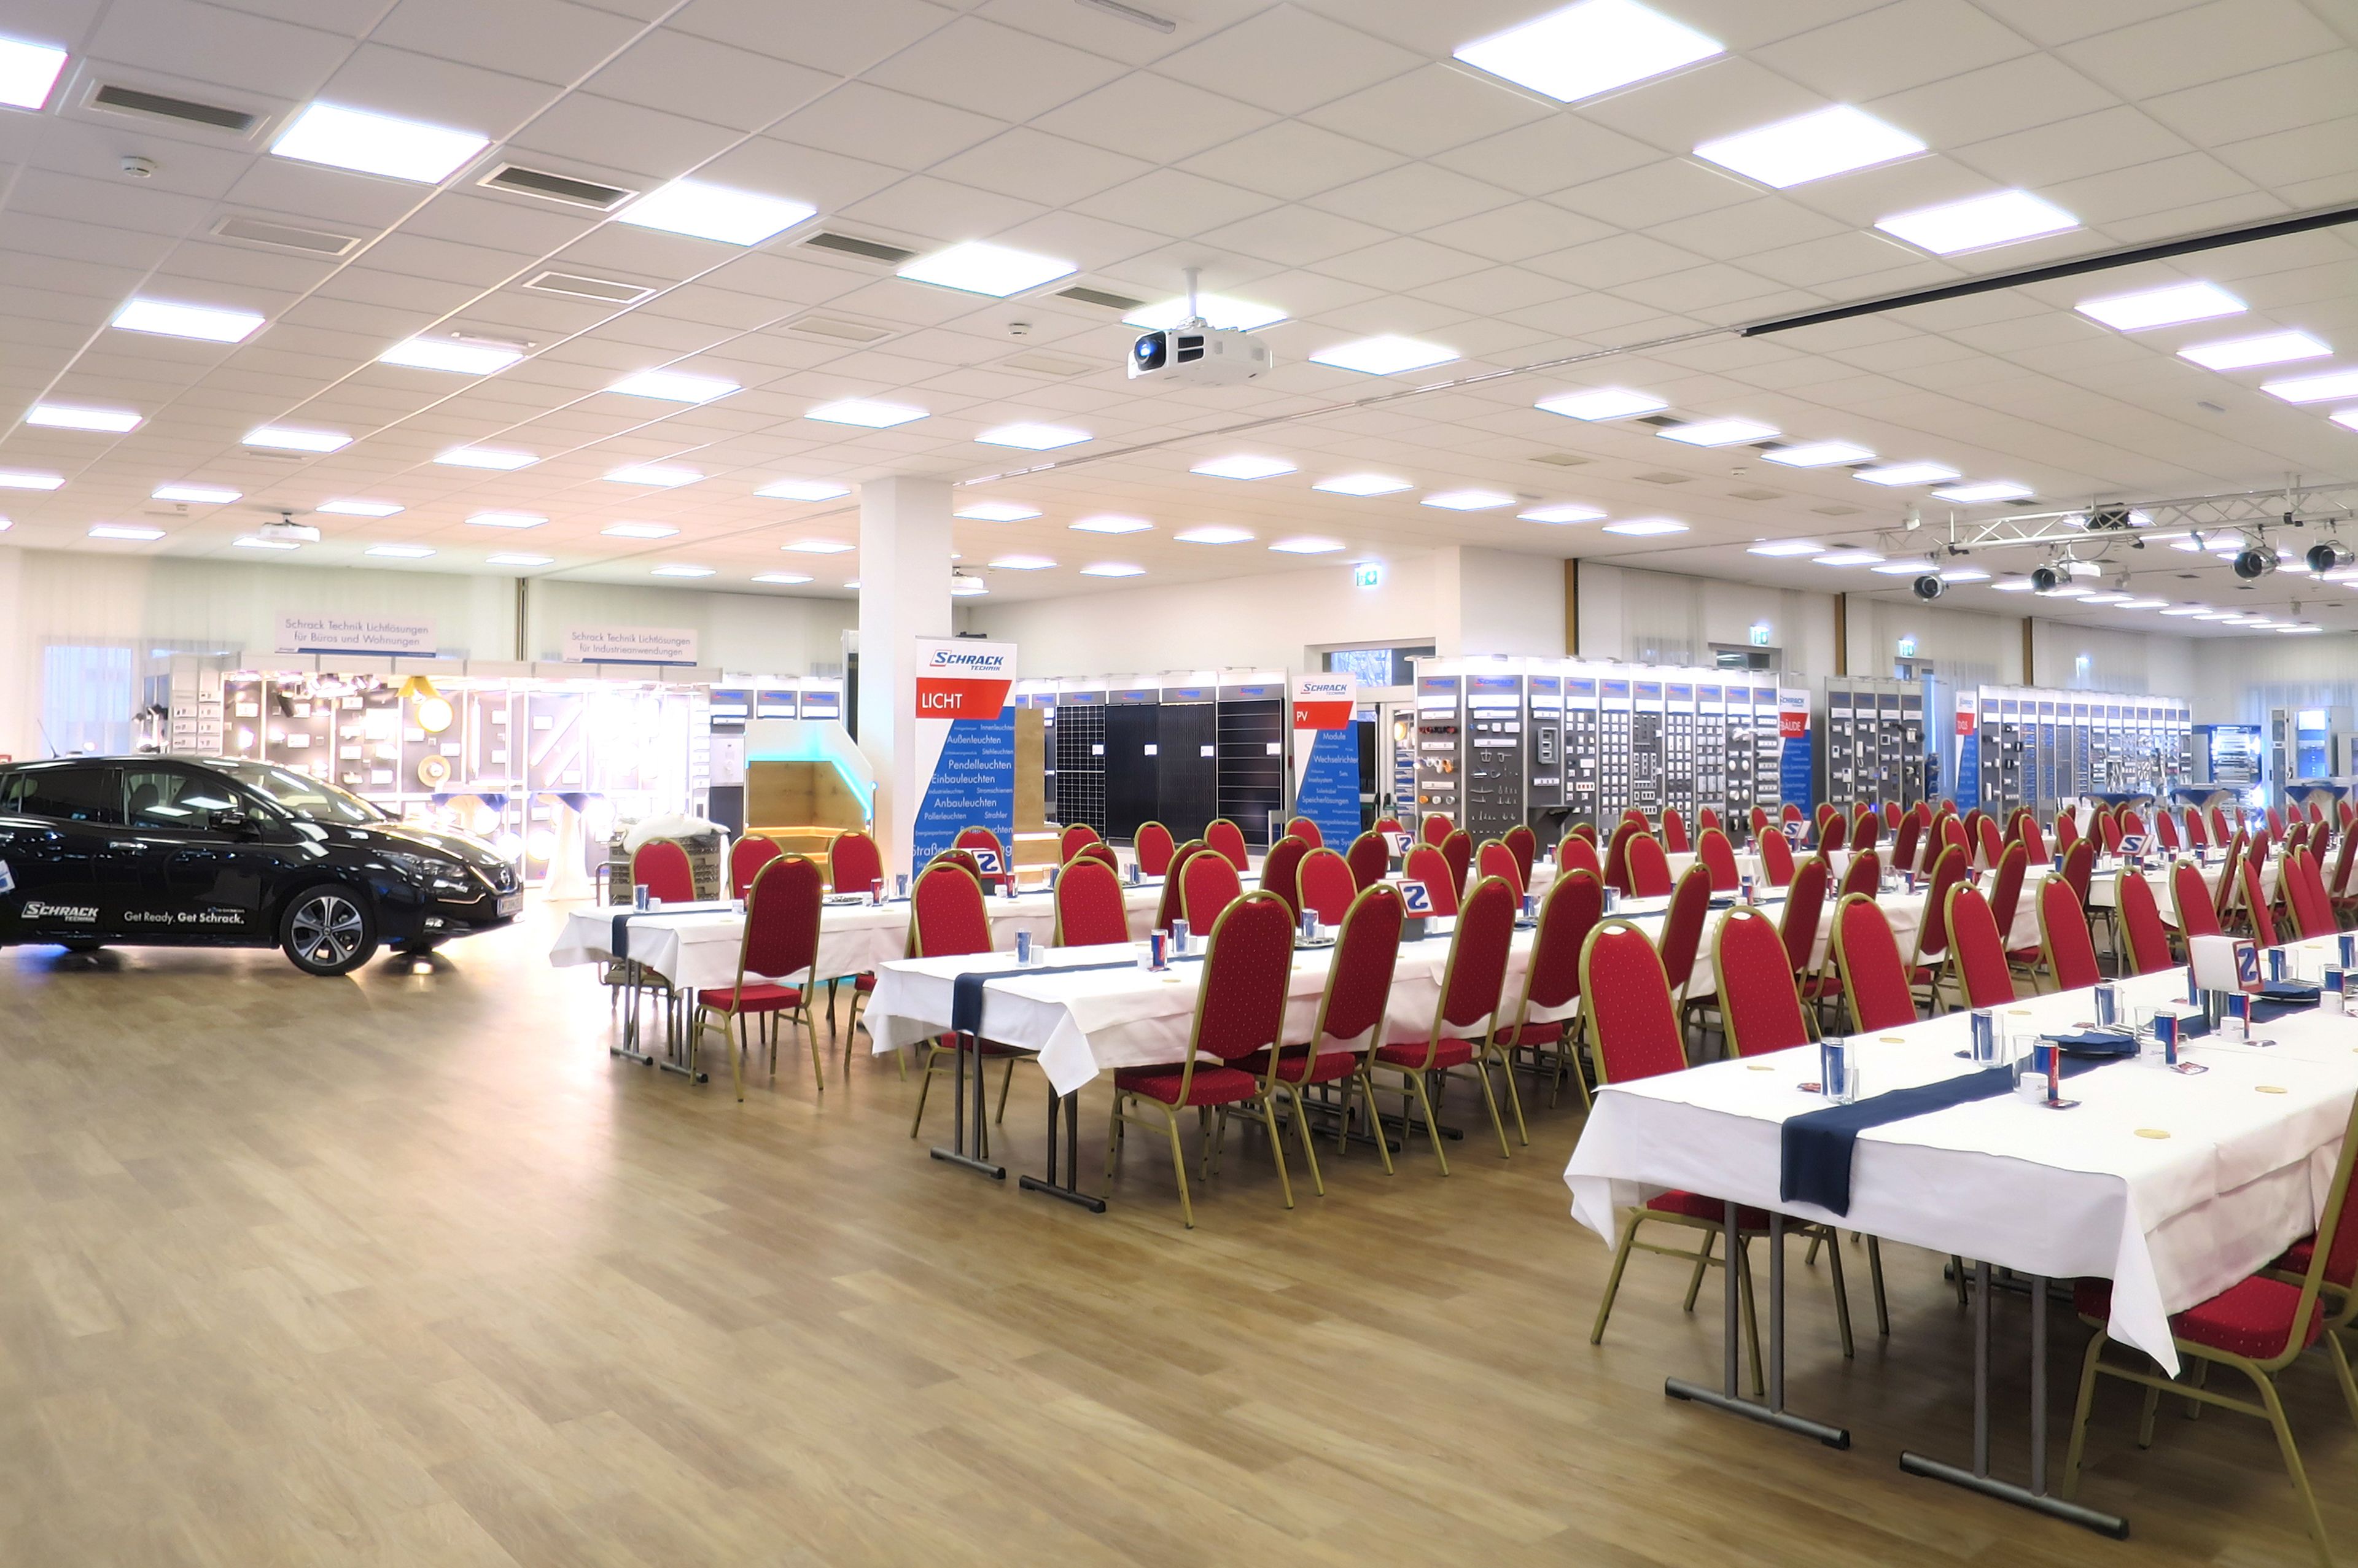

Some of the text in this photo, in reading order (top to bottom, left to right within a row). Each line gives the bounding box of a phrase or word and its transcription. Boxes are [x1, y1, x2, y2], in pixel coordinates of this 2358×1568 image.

[285, 619, 429, 636] Schrack Technik Lichtlösungen
[294, 631, 420, 648] für Büros und Wohnungen
[572, 632, 691, 647] Schrack Technik Lichtlösungen
[579, 643, 683, 658] für Industrieanwendungen
[934, 651, 1004, 666] SCHRACK
[1303, 683, 1347, 692] SCHRACK
[922, 693, 963, 708] LICHT
[1296, 711, 1308, 721] PV
[947, 734, 1001, 744] Außenleuchten
[948, 759, 1012, 770] Pendelleuchten
[1313, 755, 1358, 764] Wechselrichter
[932, 774, 995, 784] Einbauleuchten
[933, 797, 997, 808] Anbauleuchten
[924, 812, 967, 820] Pollerleuchten
[1784, 823, 1799, 835] S
[2122, 837, 2142, 852] S
[26, 902, 99, 917] SCHRACK
[124, 912, 245, 925] Get Ready. Get Schrack.
